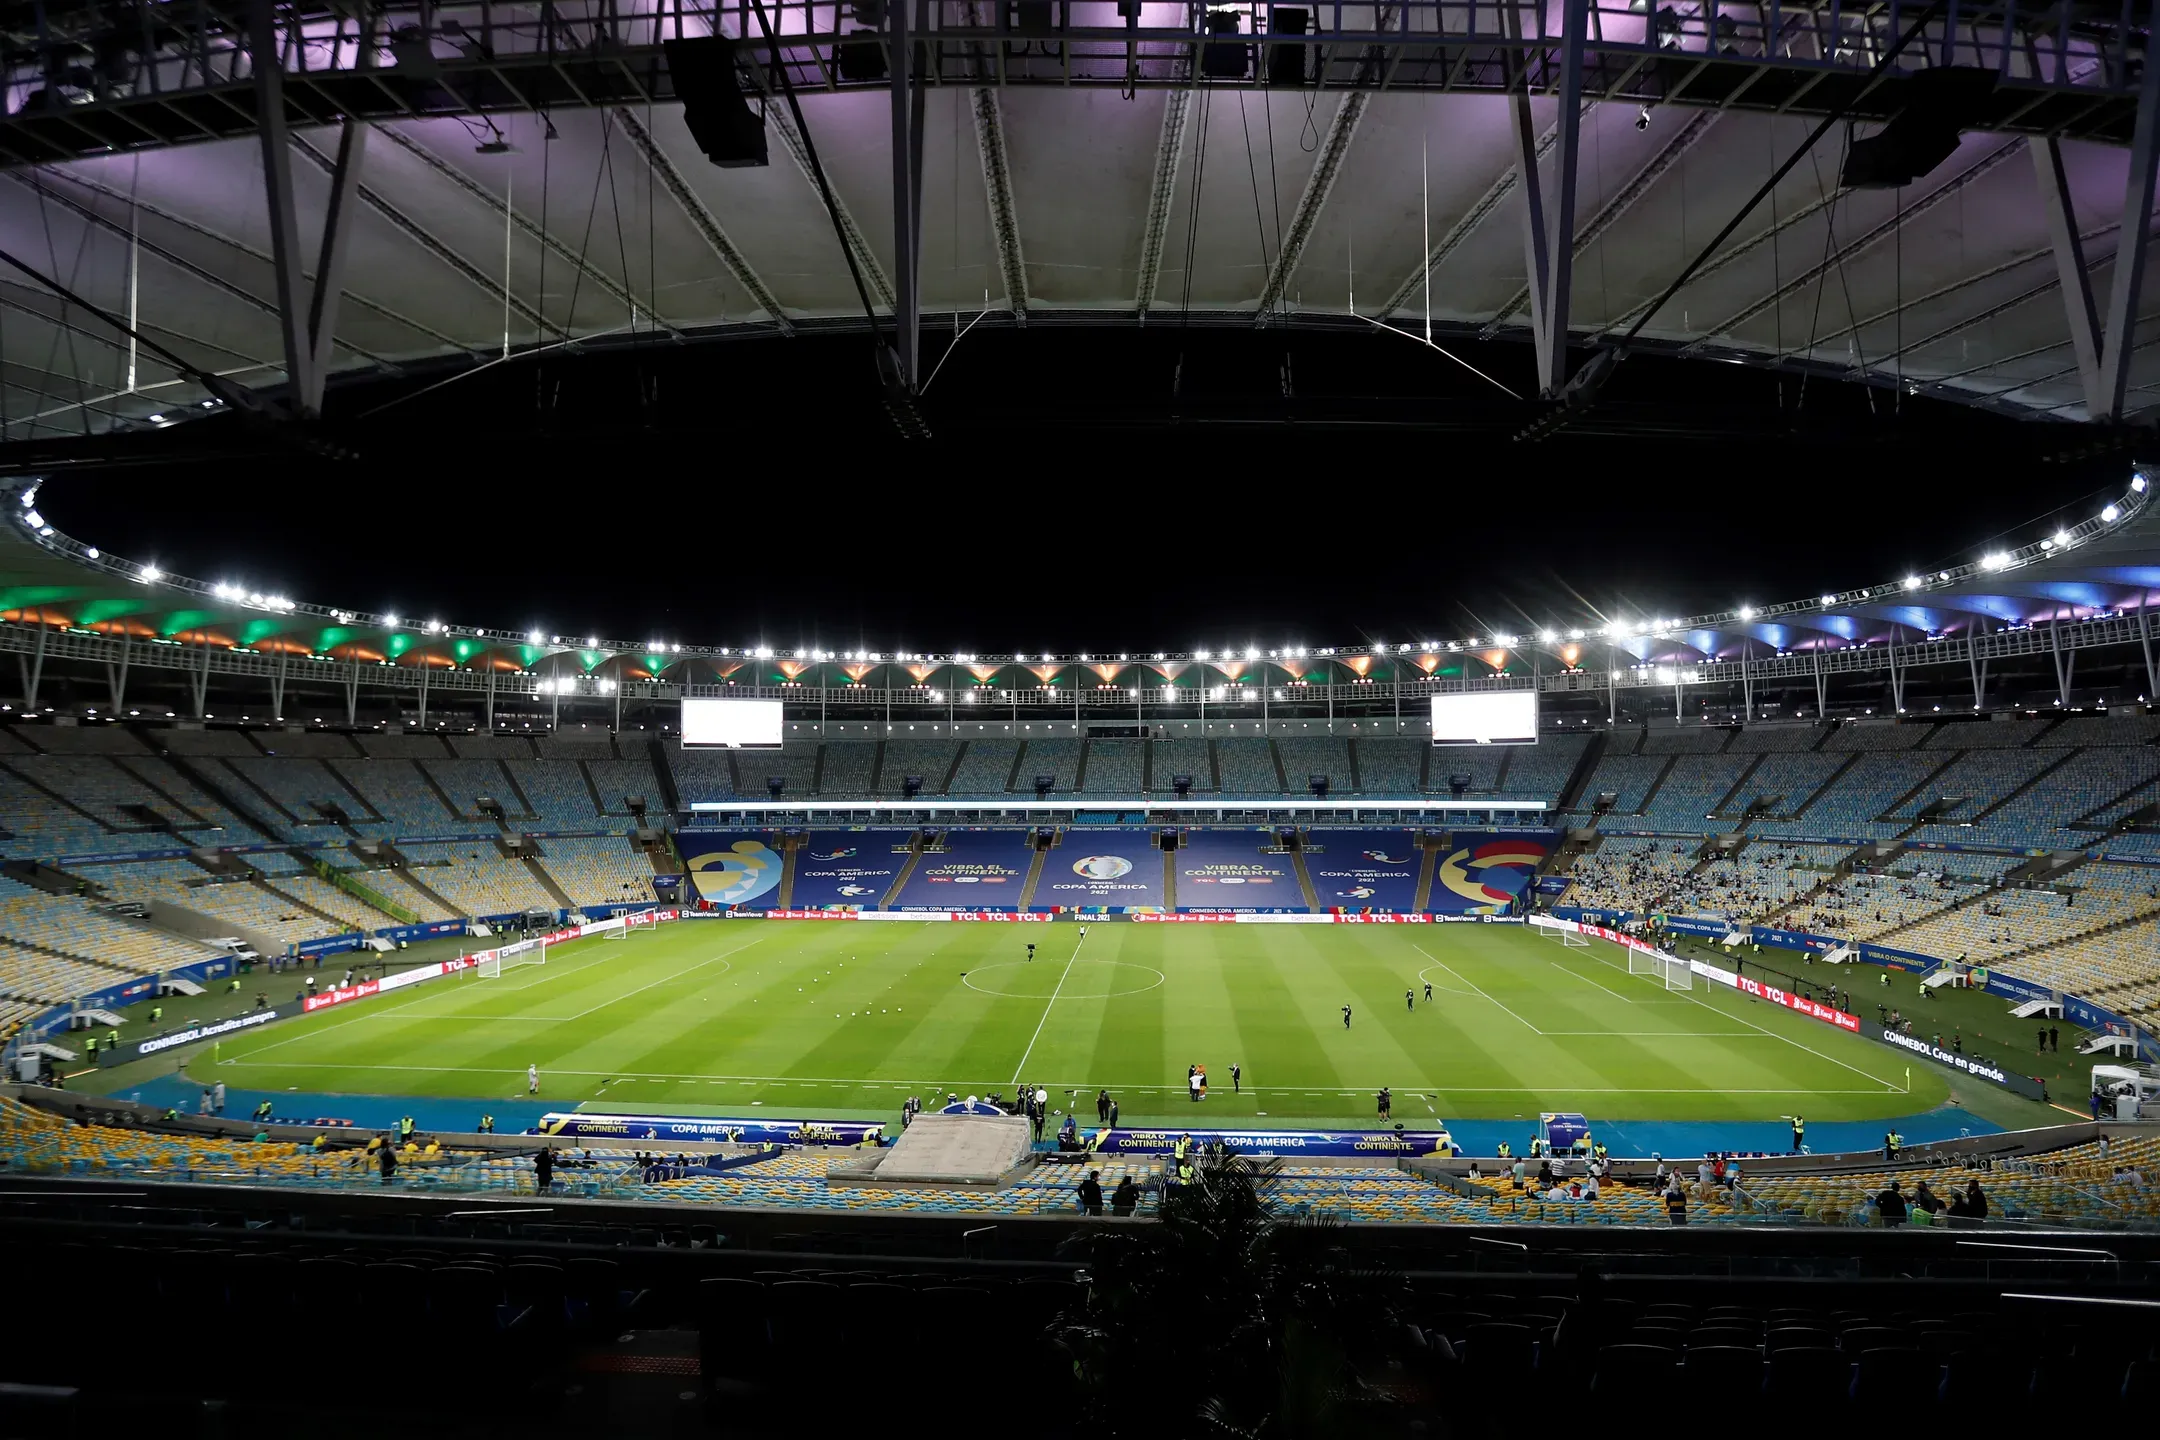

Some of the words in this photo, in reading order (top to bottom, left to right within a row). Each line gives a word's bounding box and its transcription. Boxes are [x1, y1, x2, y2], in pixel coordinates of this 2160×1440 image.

[629, 914, 649, 925] TCL
[654, 911, 674, 920] TCL
[956, 912, 980, 921] TCL
[986, 912, 1010, 921] TCL
[1016, 912, 1040, 921] TCL
[1339, 914, 1364, 923] TCL
[1370, 914, 1395, 923] TCL
[1400, 914, 1426, 923] TCL
[1582, 924, 1600, 936] TCL
[1604, 930, 1618, 942] TCL
[1867, 951, 1884, 960] VIBRA
[446, 959, 468, 971] TCL
[472, 952, 492, 965] TCL
[1740, 977, 1761, 995] TCL
[1765, 986, 1787, 1005] TCL
[139, 1029, 200, 1053] CONMEBOL
[200, 1018, 242, 1036] Acredite
[1883, 1030, 1932, 1056] CONMEBOL
[1932, 1047, 1954, 1064] Cree
[1955, 1059, 1968, 1069] en
[1968, 1062, 2008, 1083] grande.
[577, 1124, 629, 1133] CONTINENTE.
[671, 1124, 698, 1134] COPA
[1119, 1139, 1175, 1148] CONTINENTE
[1224, 1137, 1254, 1146] COPA
[1255, 1137, 1306, 1147] AMERICA
[1354, 1142, 1414, 1151] CONTINENTE.
